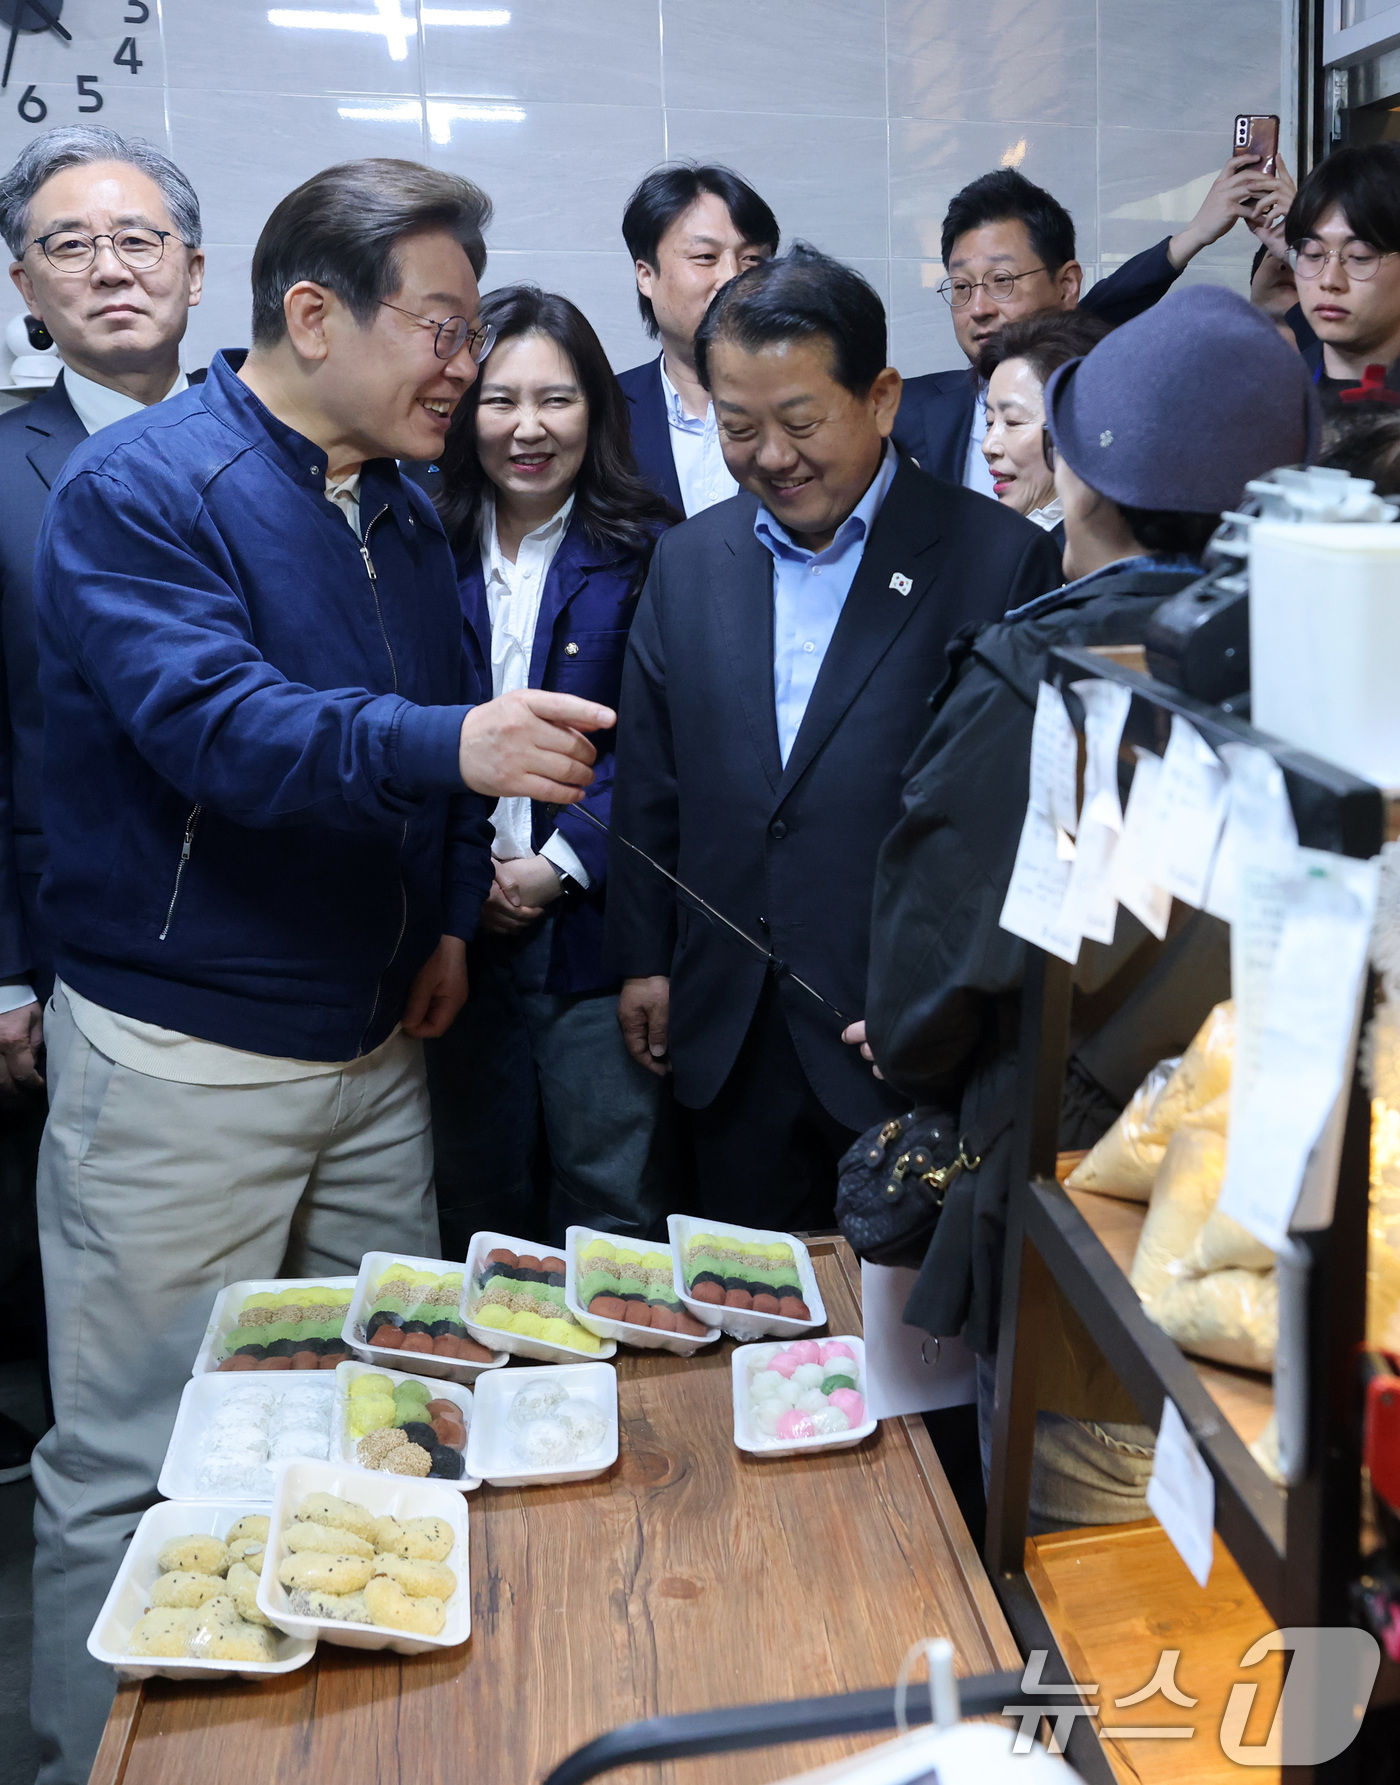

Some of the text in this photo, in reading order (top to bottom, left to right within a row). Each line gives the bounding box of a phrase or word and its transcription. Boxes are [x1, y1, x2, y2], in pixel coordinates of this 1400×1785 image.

[113, 36, 143, 74] 4
[18, 85, 47, 124] 6
[77, 75, 104, 113] 5
